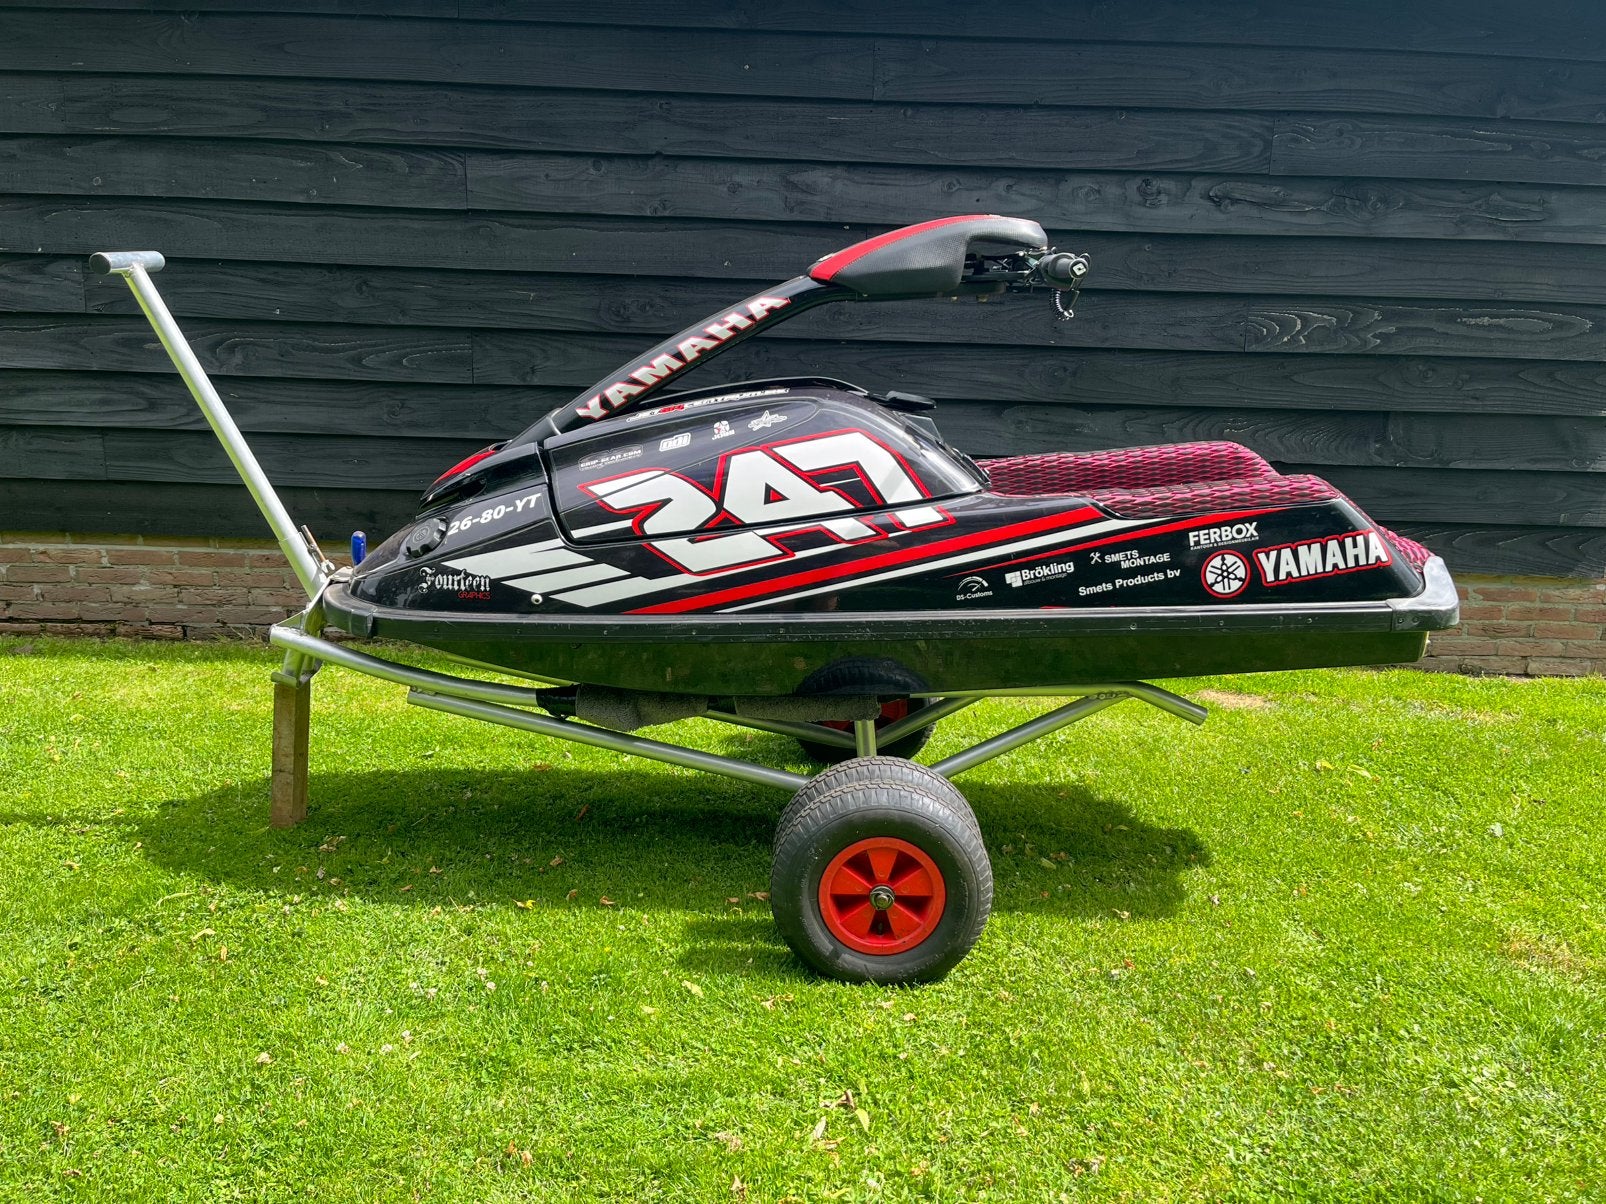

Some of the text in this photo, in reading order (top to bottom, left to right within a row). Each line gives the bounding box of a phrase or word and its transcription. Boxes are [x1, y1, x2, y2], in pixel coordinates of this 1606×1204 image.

[575, 296, 791, 420] YAMAHA
[447, 493, 542, 536] 26-80-YT
[578, 429, 955, 575] 247
[1188, 521, 1259, 547] FERBOX
[1104, 549, 1140, 563] SMETS
[1120, 552, 1171, 569] MONTAGE
[1255, 530, 1391, 585] YAMAHA
[418, 566, 491, 593] Fourteen
[1021, 561, 1075, 581] Brökling
[1078, 568, 1181, 596] Smets Products bv
[457, 591, 491, 600] GRAPHICS
[956, 590, 993, 601] DS-Customs
